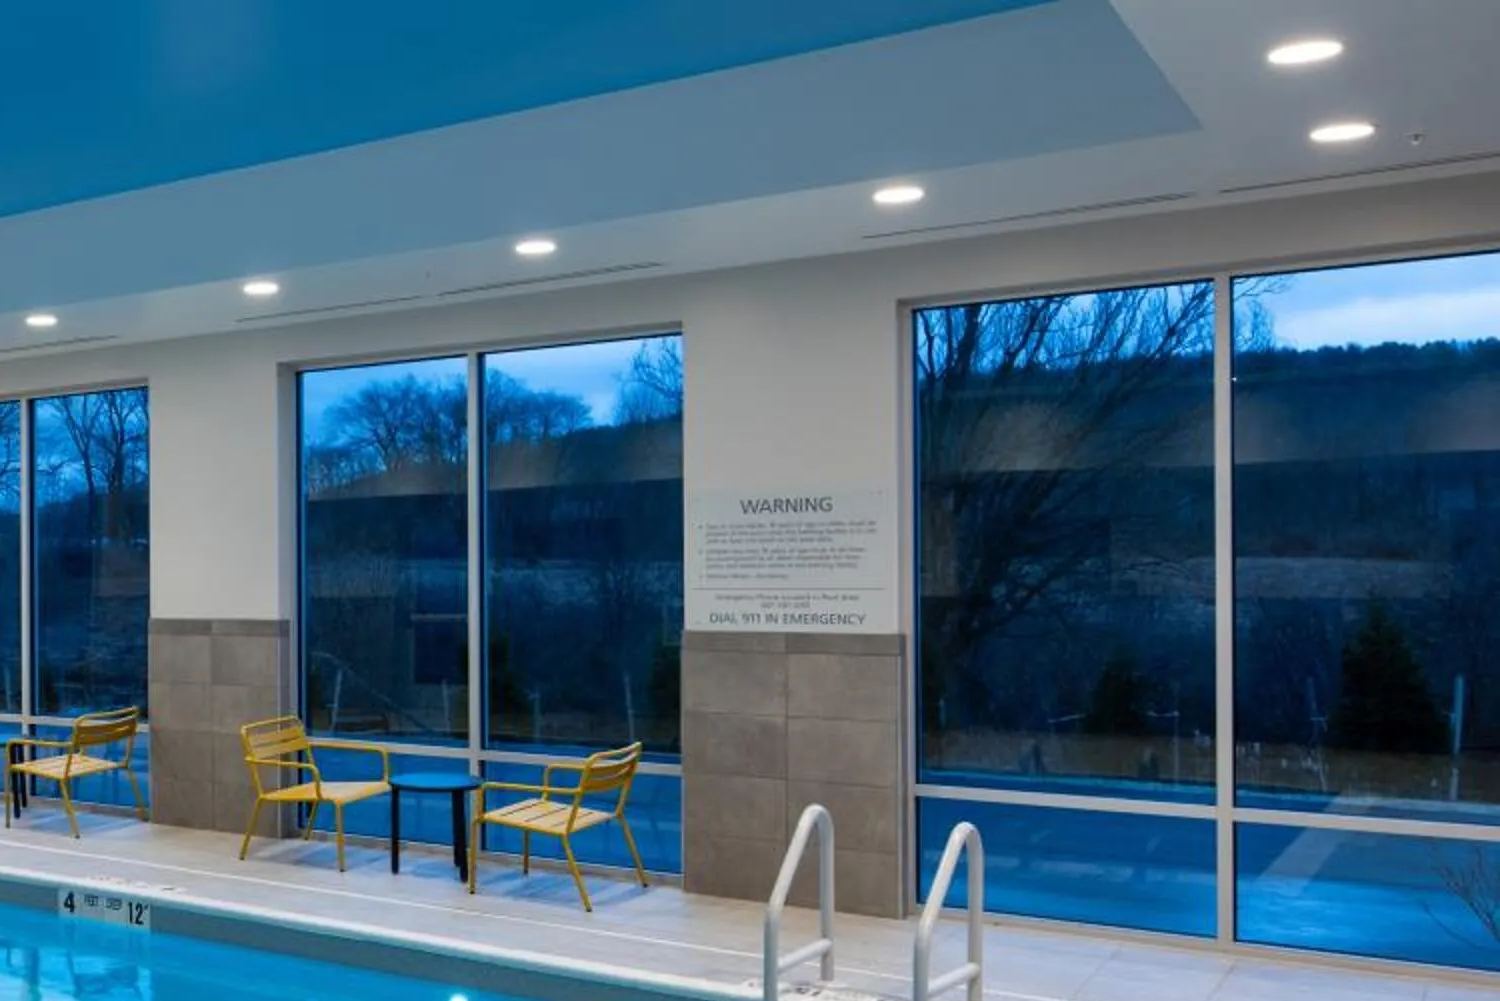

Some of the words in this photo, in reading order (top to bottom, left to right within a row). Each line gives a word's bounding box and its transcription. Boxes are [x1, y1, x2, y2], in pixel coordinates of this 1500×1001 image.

[740, 497, 833, 514] WARNING
[709, 612, 738, 625] DIAL
[742, 612, 761, 625] 911
[765, 612, 779, 625] IN
[782, 612, 867, 625] EMERGENCY
[63, 891, 76, 913] 4
